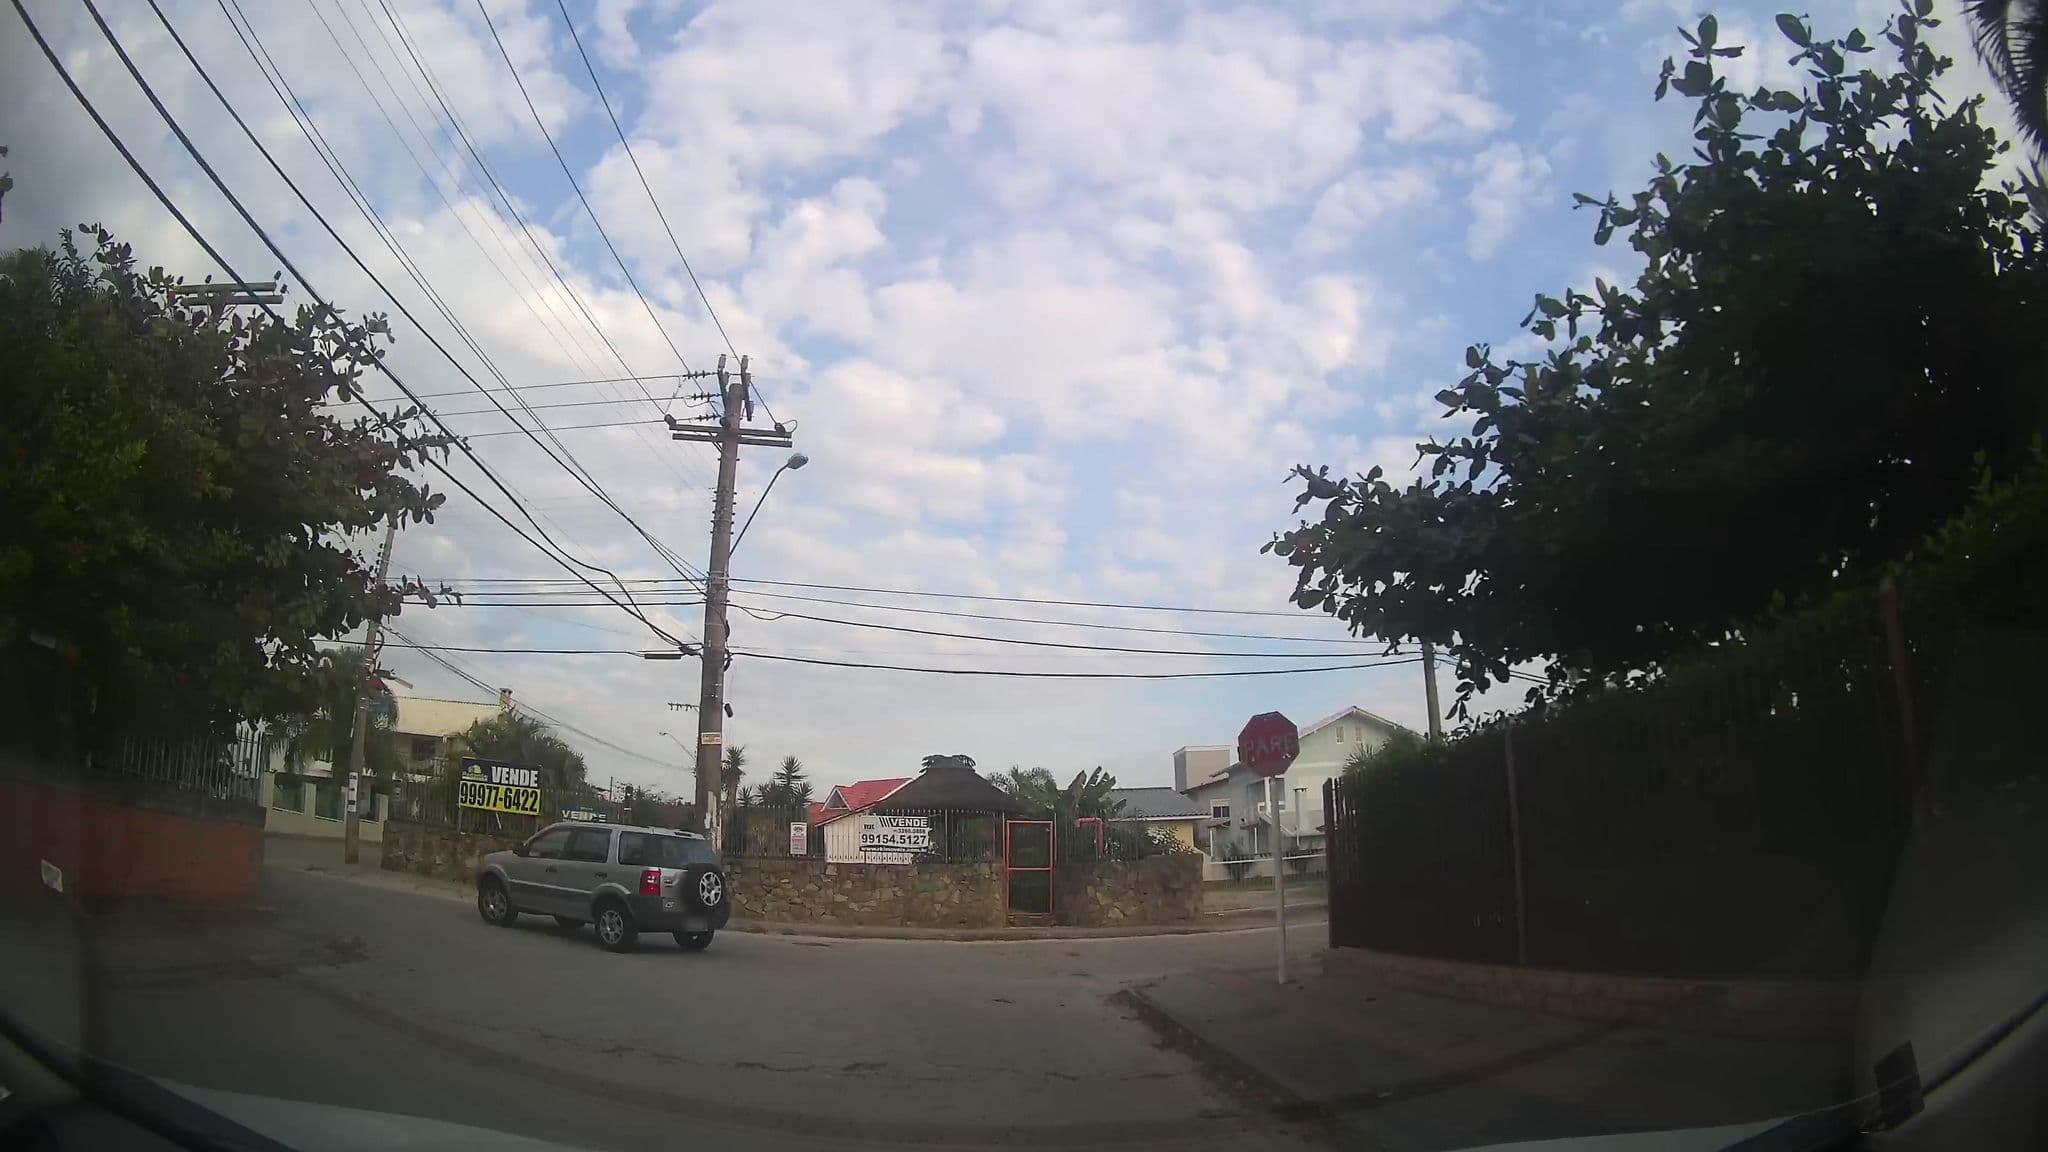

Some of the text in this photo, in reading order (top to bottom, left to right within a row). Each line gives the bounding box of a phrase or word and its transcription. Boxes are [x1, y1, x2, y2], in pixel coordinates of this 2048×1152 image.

[1242, 735, 1297, 755] PARE
[491, 766, 539, 788] VENDE
[460, 782, 538, 812] 99977-6422
[561, 810, 607, 823] VENDE
[891, 818, 928, 828] VENDE
[861, 833, 927, 845] 99154.5127
